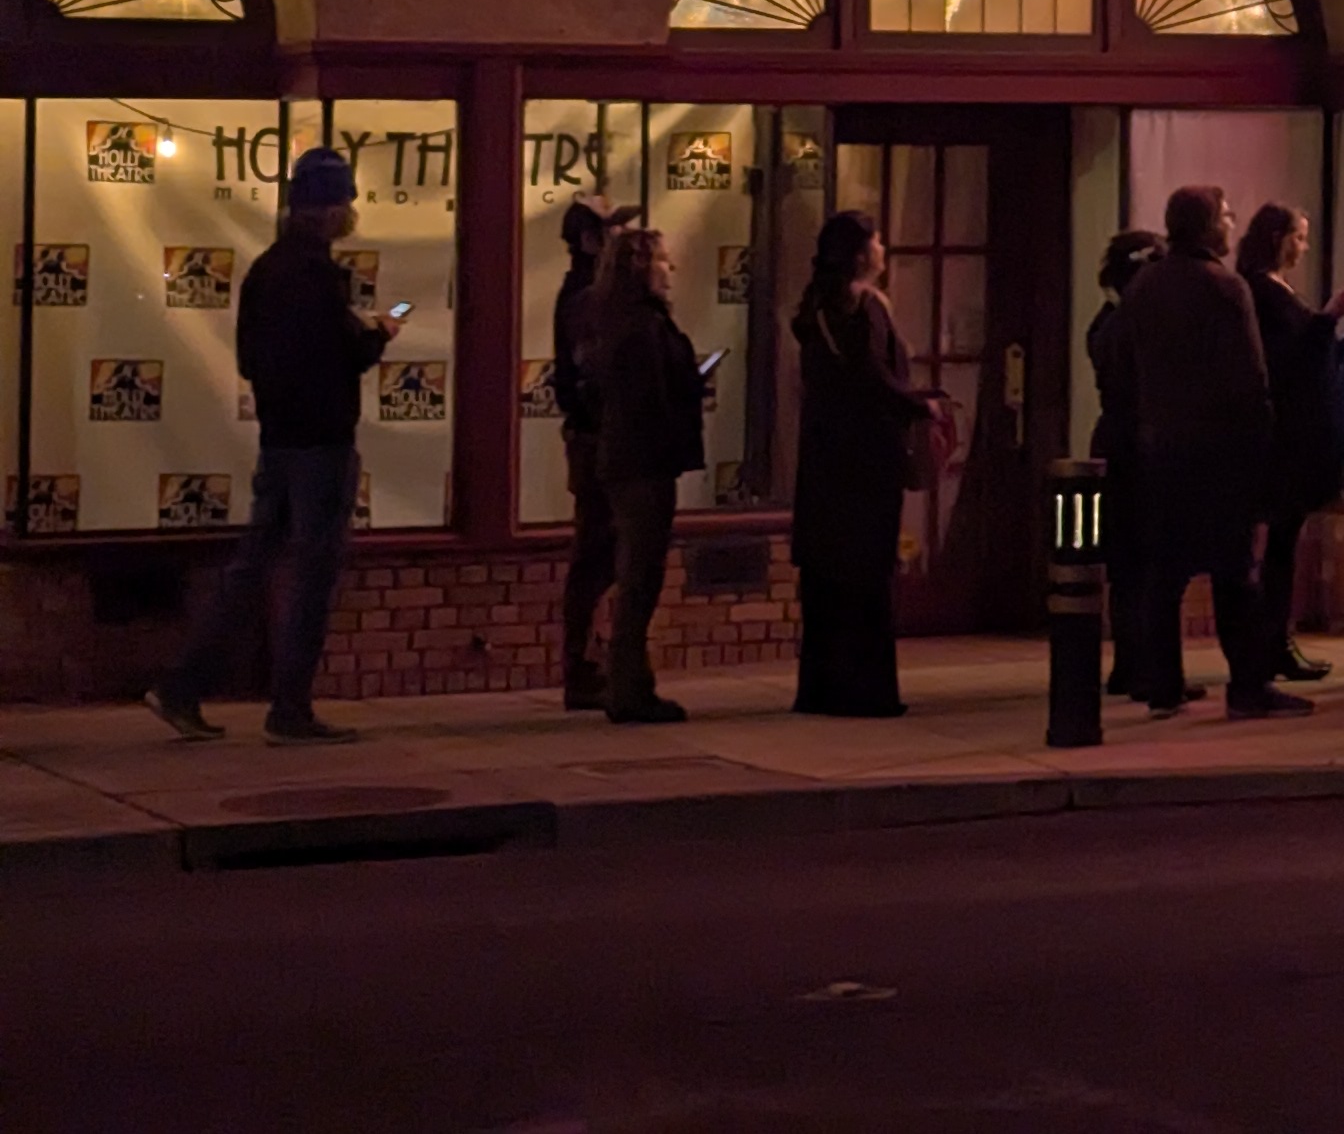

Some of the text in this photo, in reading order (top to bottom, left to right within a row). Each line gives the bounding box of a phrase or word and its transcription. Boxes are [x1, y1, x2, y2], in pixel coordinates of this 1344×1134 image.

[98, 149, 141, 167] HOLLY
[213, 125, 607, 186] HOY THTRE
[89, 166, 154, 182] THEATRE
